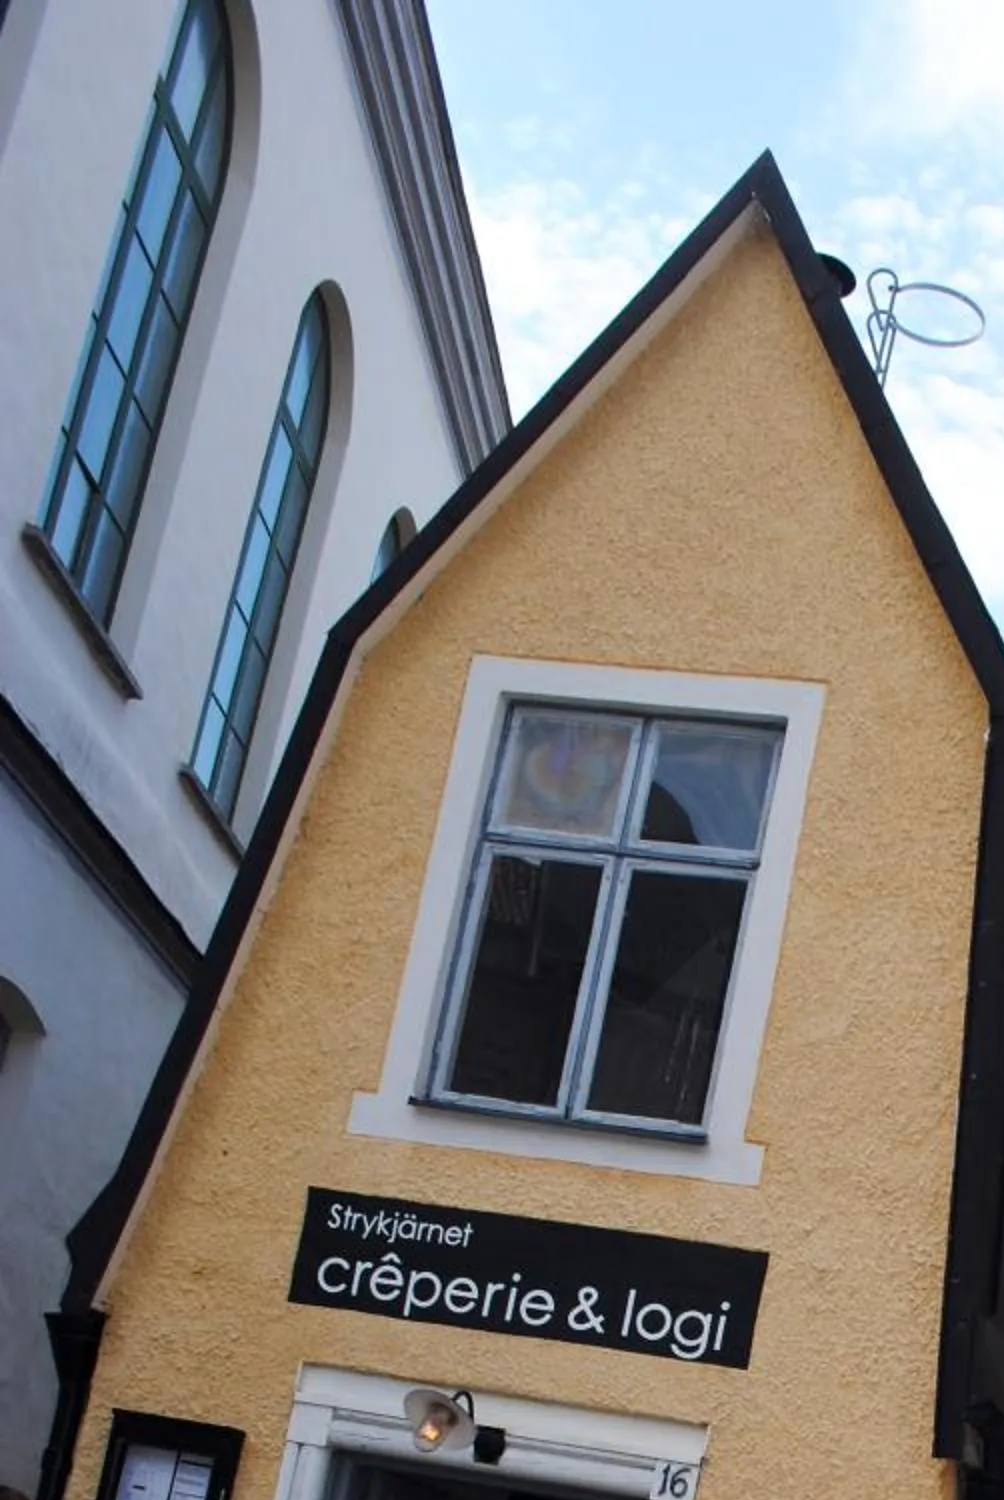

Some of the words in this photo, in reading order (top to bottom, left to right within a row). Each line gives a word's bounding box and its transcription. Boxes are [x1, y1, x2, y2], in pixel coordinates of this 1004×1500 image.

[327, 1203, 474, 1248] Strykjärnet
[317, 1252, 555, 1326] crêperie
[567, 1286, 605, 1334] &
[621, 1288, 731, 1359] logi
[658, 1463, 692, 1499] 16
